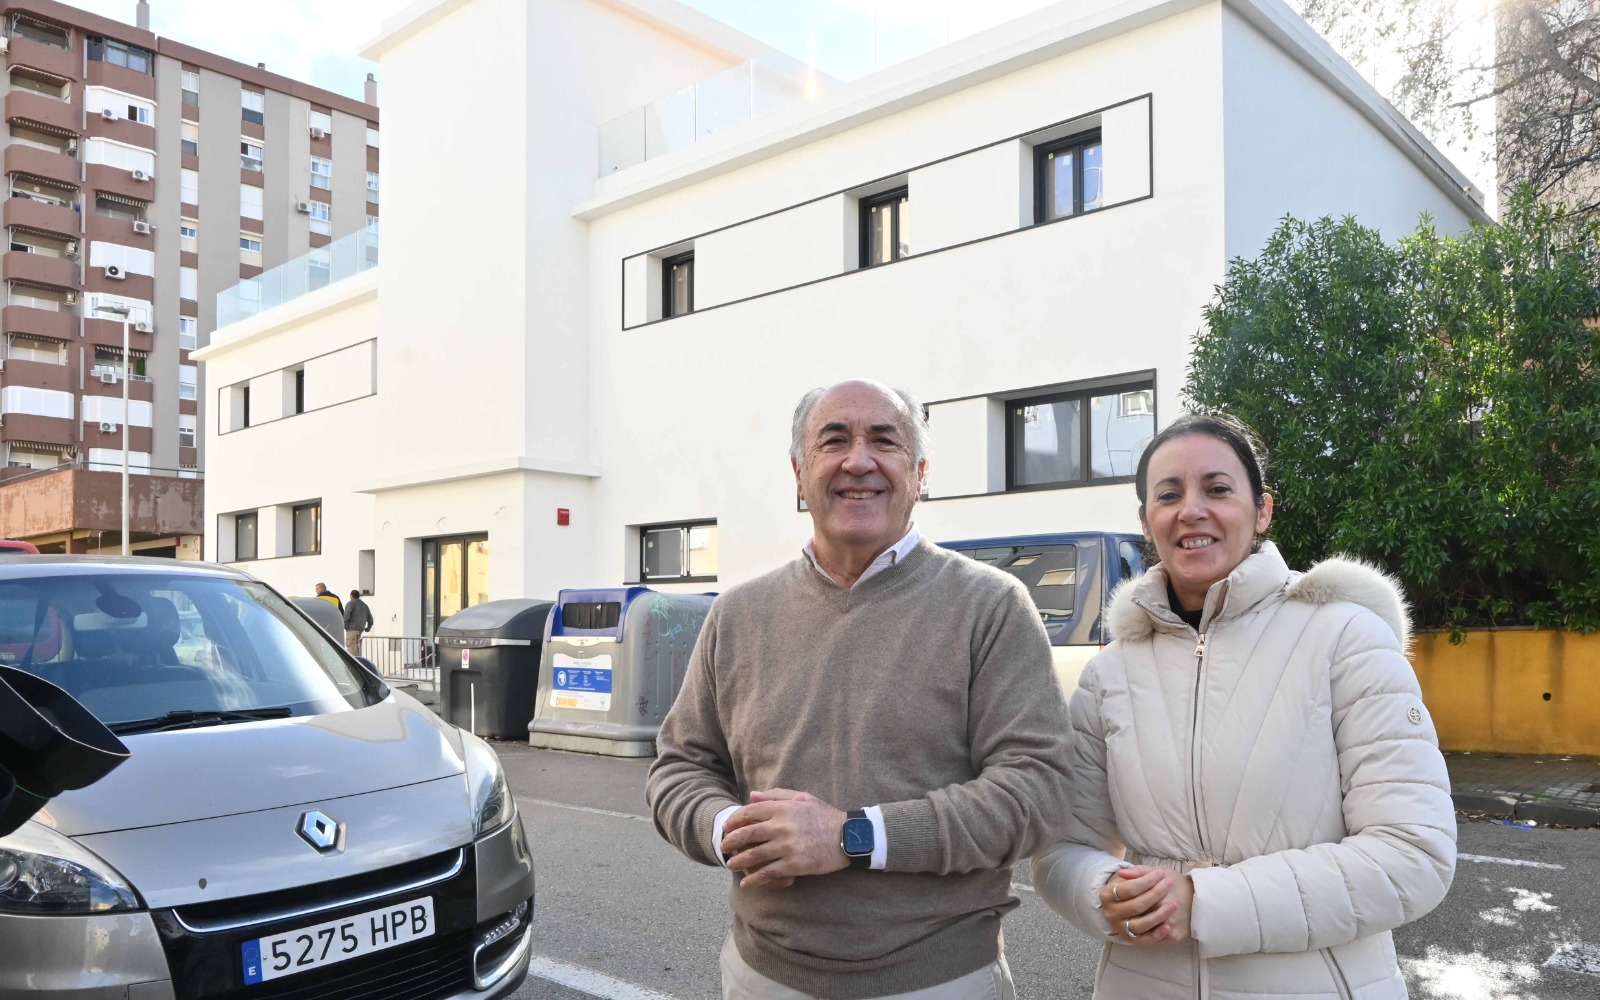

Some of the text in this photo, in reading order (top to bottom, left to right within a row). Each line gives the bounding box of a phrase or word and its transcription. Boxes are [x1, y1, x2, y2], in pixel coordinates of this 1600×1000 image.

[271, 905, 427, 971] 5275 HPB
[248, 966, 256, 976] E
